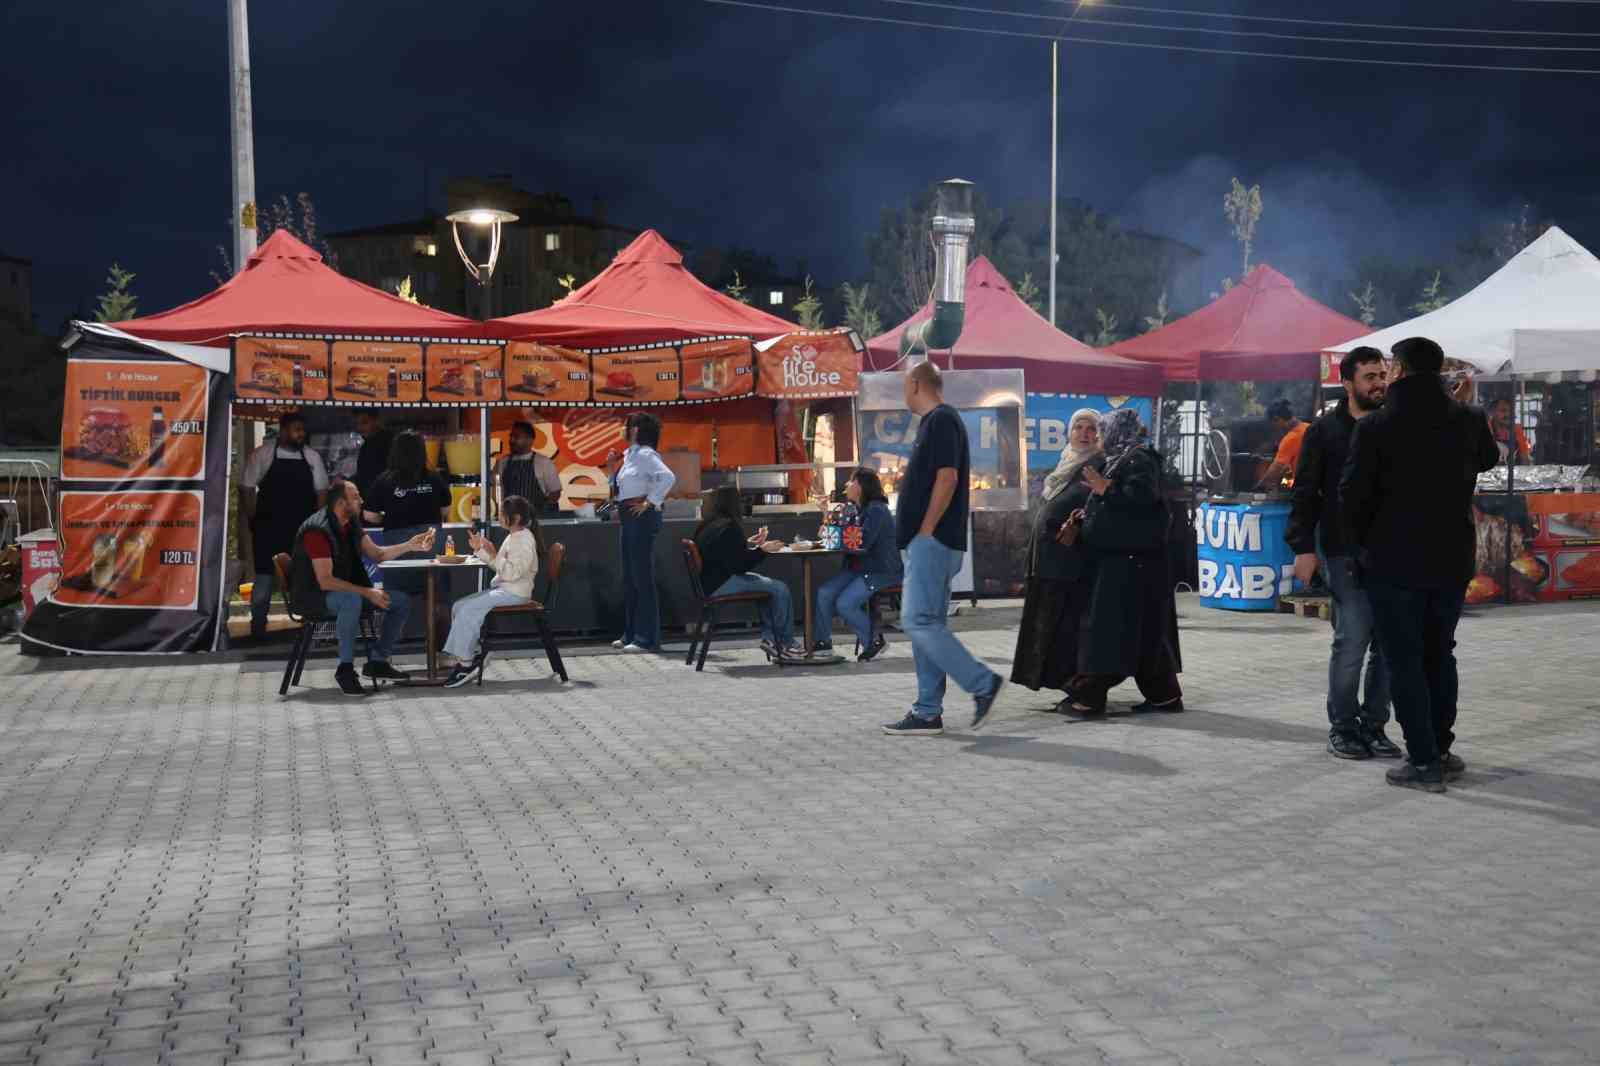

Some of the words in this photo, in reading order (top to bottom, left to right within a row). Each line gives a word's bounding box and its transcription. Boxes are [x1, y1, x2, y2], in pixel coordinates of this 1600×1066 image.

[172, 422, 190, 433] 450
[191, 421, 202, 432] TL
[164, 551, 181, 563] 120
[183, 551, 194, 564] TL
